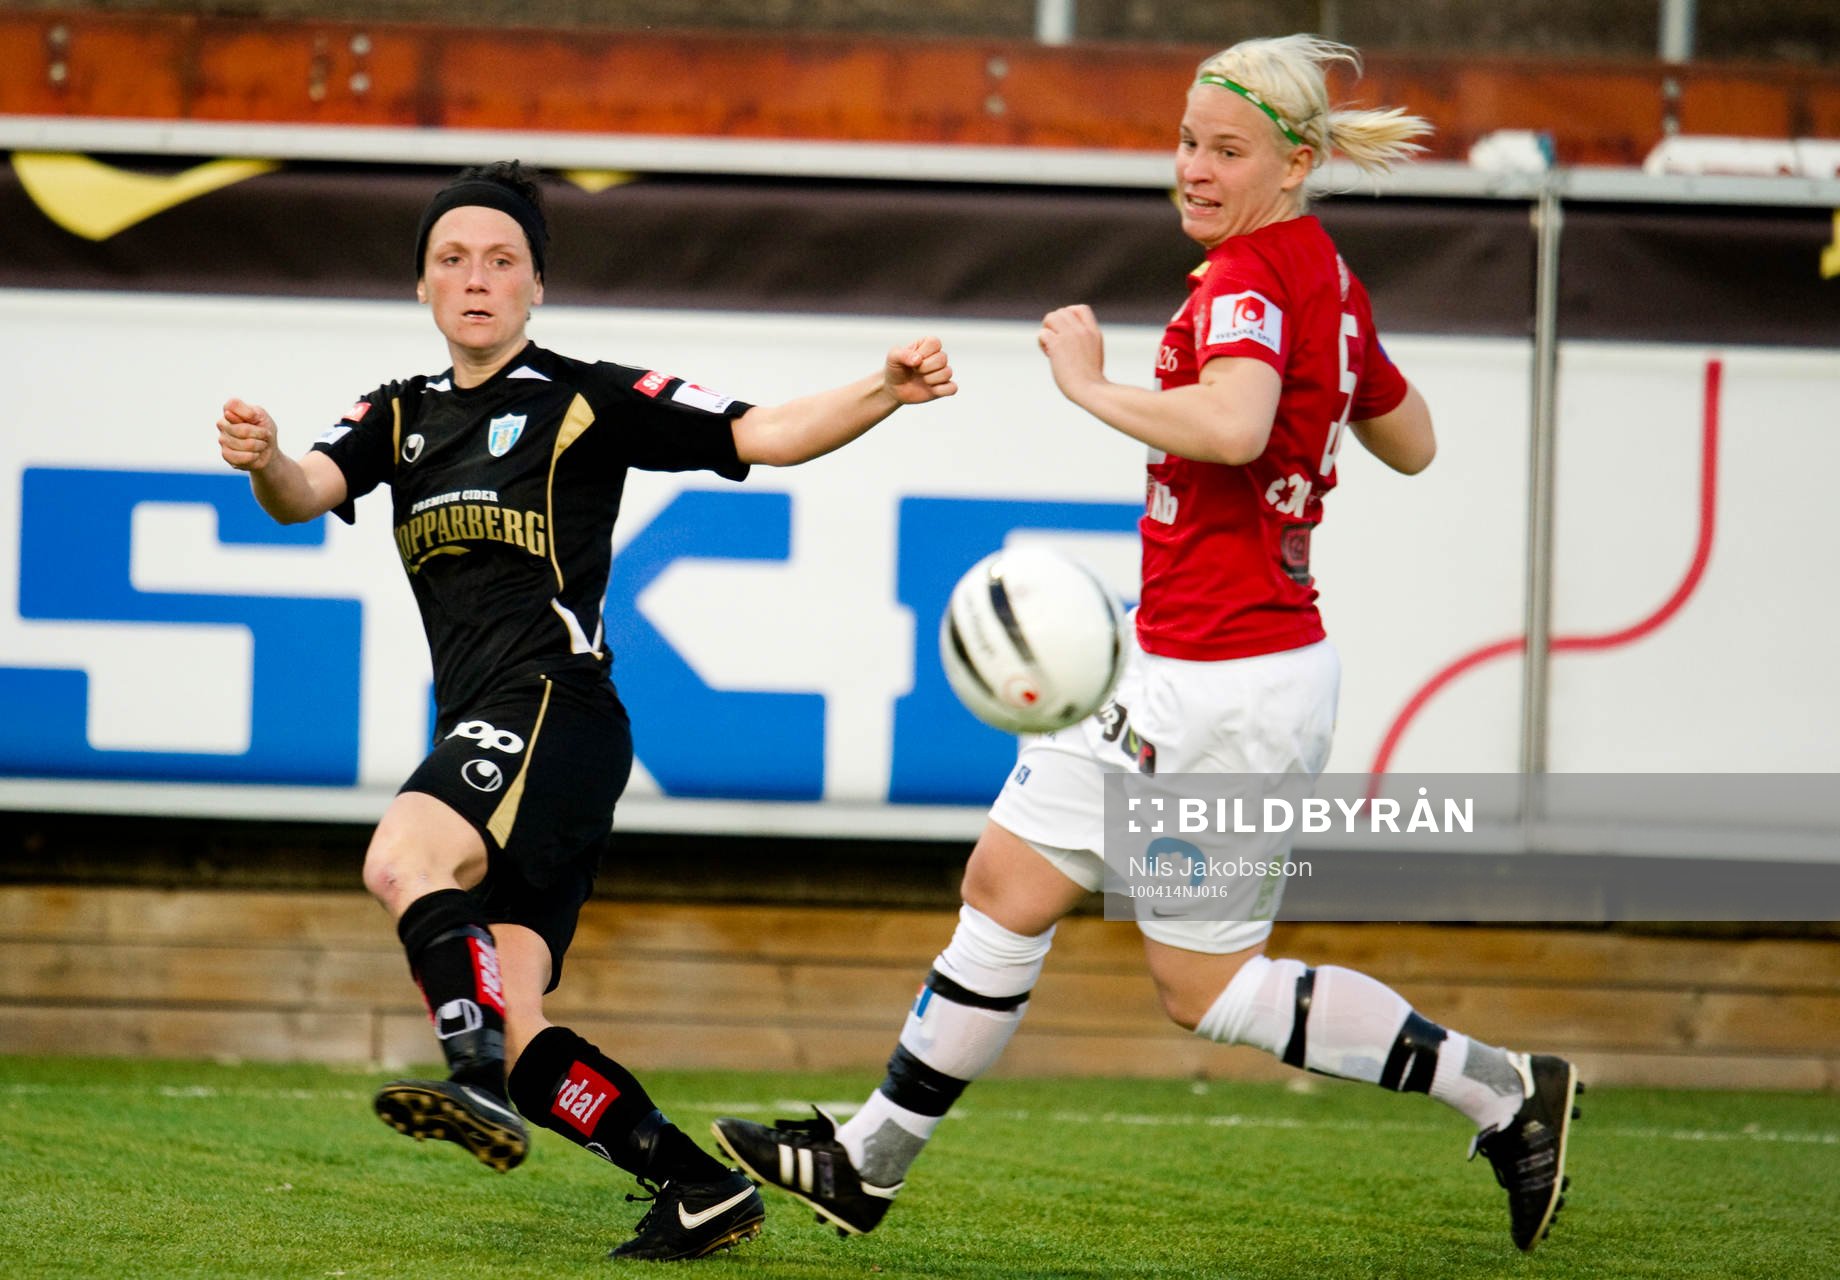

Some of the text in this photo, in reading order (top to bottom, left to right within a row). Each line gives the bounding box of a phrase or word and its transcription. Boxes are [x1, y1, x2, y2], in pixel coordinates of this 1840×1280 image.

[411, 489, 498, 515] PREMIUM CIDER
[394, 504, 546, 561] OPPARBERG
